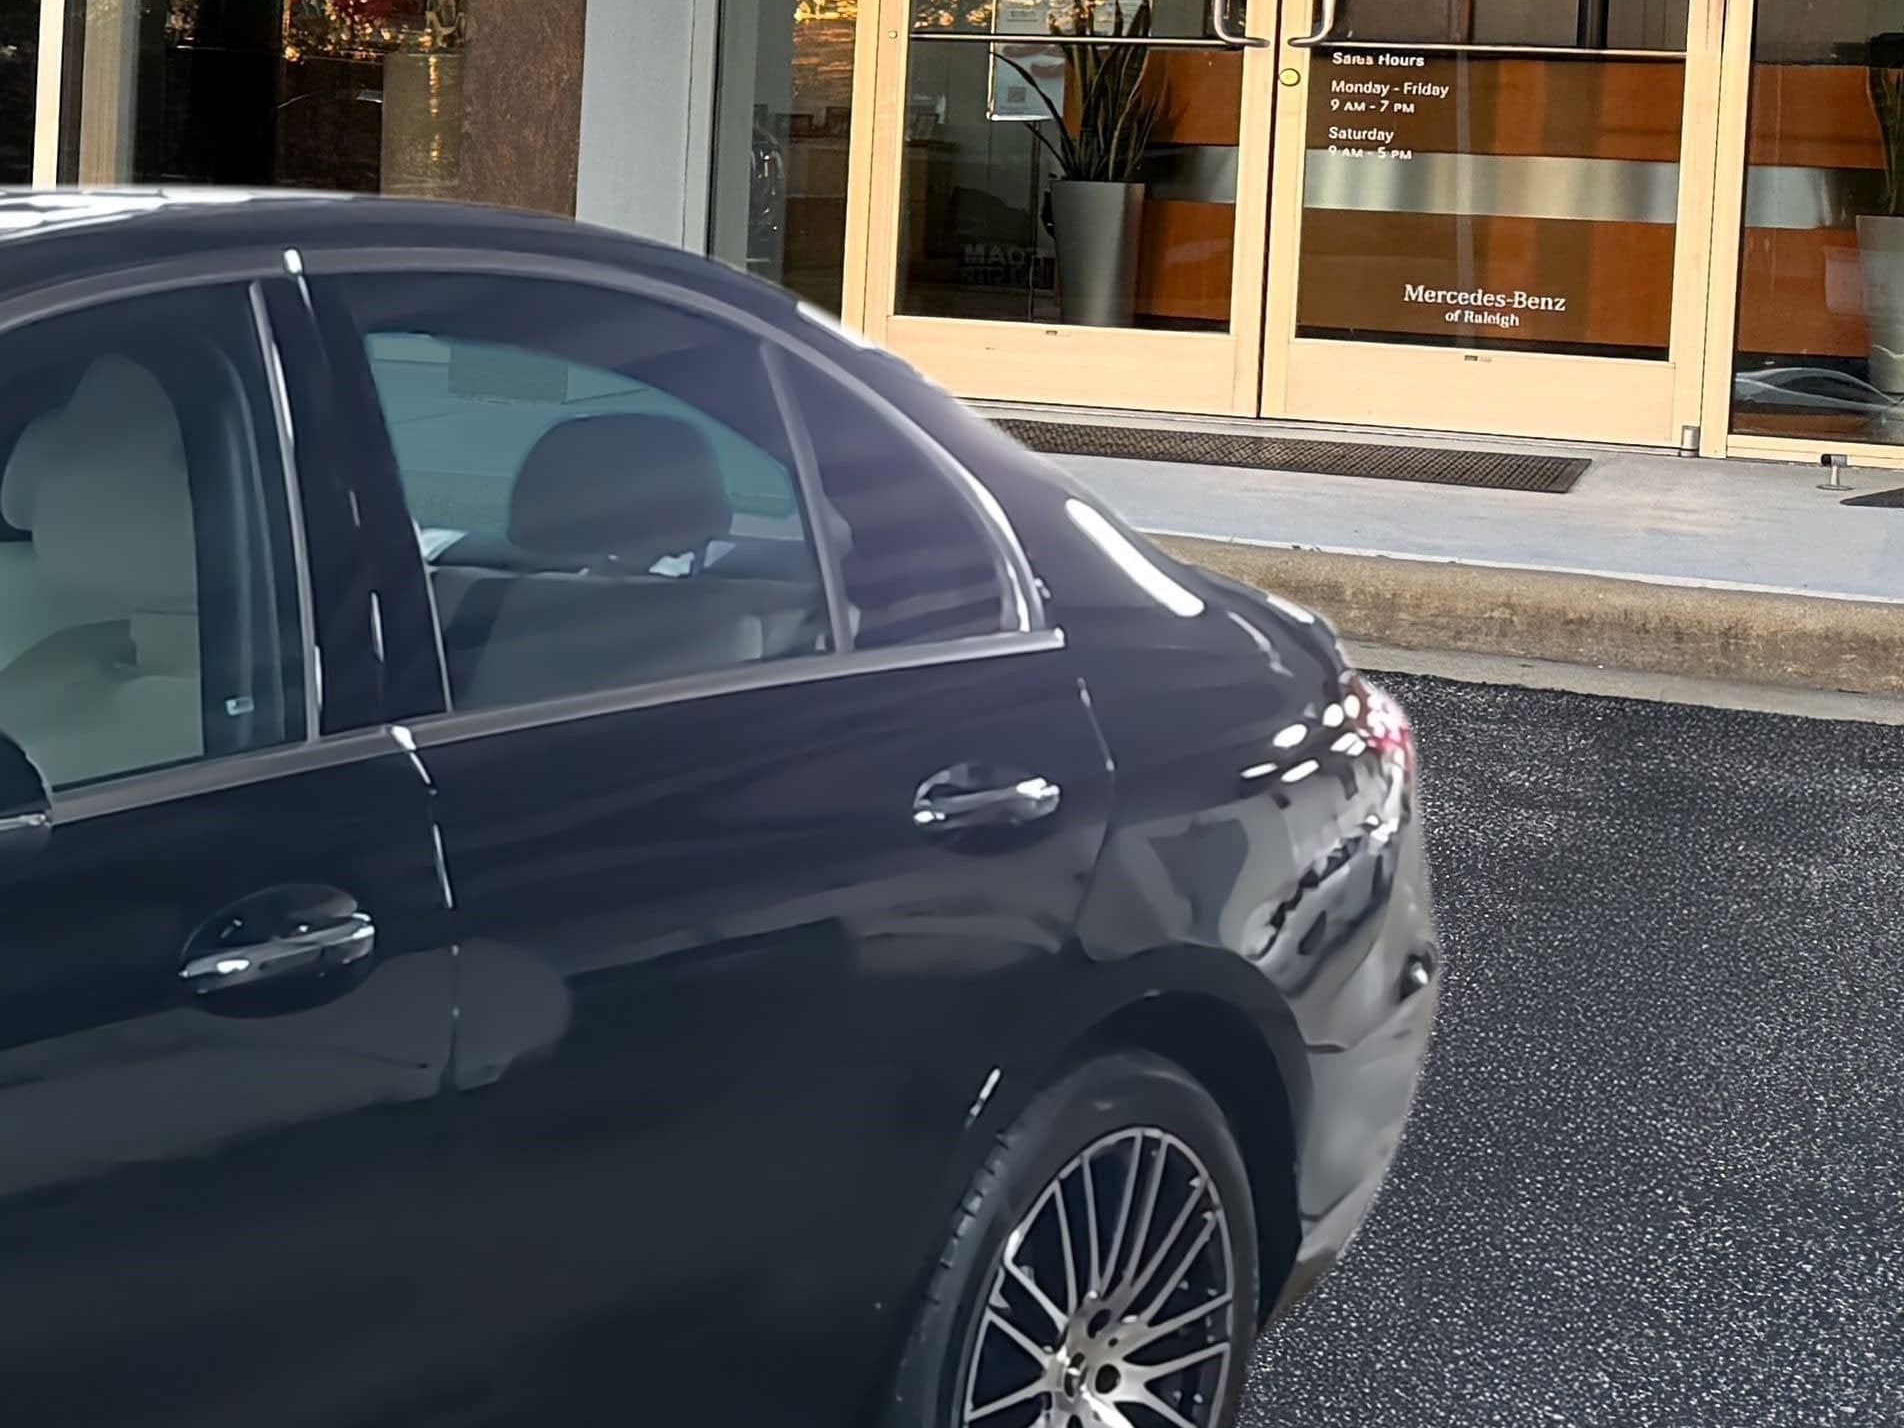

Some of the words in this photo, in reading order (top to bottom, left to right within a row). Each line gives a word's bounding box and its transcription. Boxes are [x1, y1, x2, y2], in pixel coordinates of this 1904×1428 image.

[1377, 53, 1425, 67] Hours
[1331, 79, 1390, 98] Monday
[1403, 82, 1450, 99] Friday
[1330, 98, 1340, 112] 9
[1343, 101, 1366, 112] AM
[1379, 99, 1389, 113] 7
[1393, 103, 1415, 114] PM
[1328, 126, 1394, 145] Saturday
[1328, 145, 1338, 157] 9
[1341, 147, 1364, 159] AM
[1377, 146, 1387, 160] 5
[1391, 149, 1413, 160] PM
[1403, 283, 1566, 312] Mercedes-Benz
[1444, 310, 1460, 322] of
[1463, 310, 1520, 329] Raleigh
